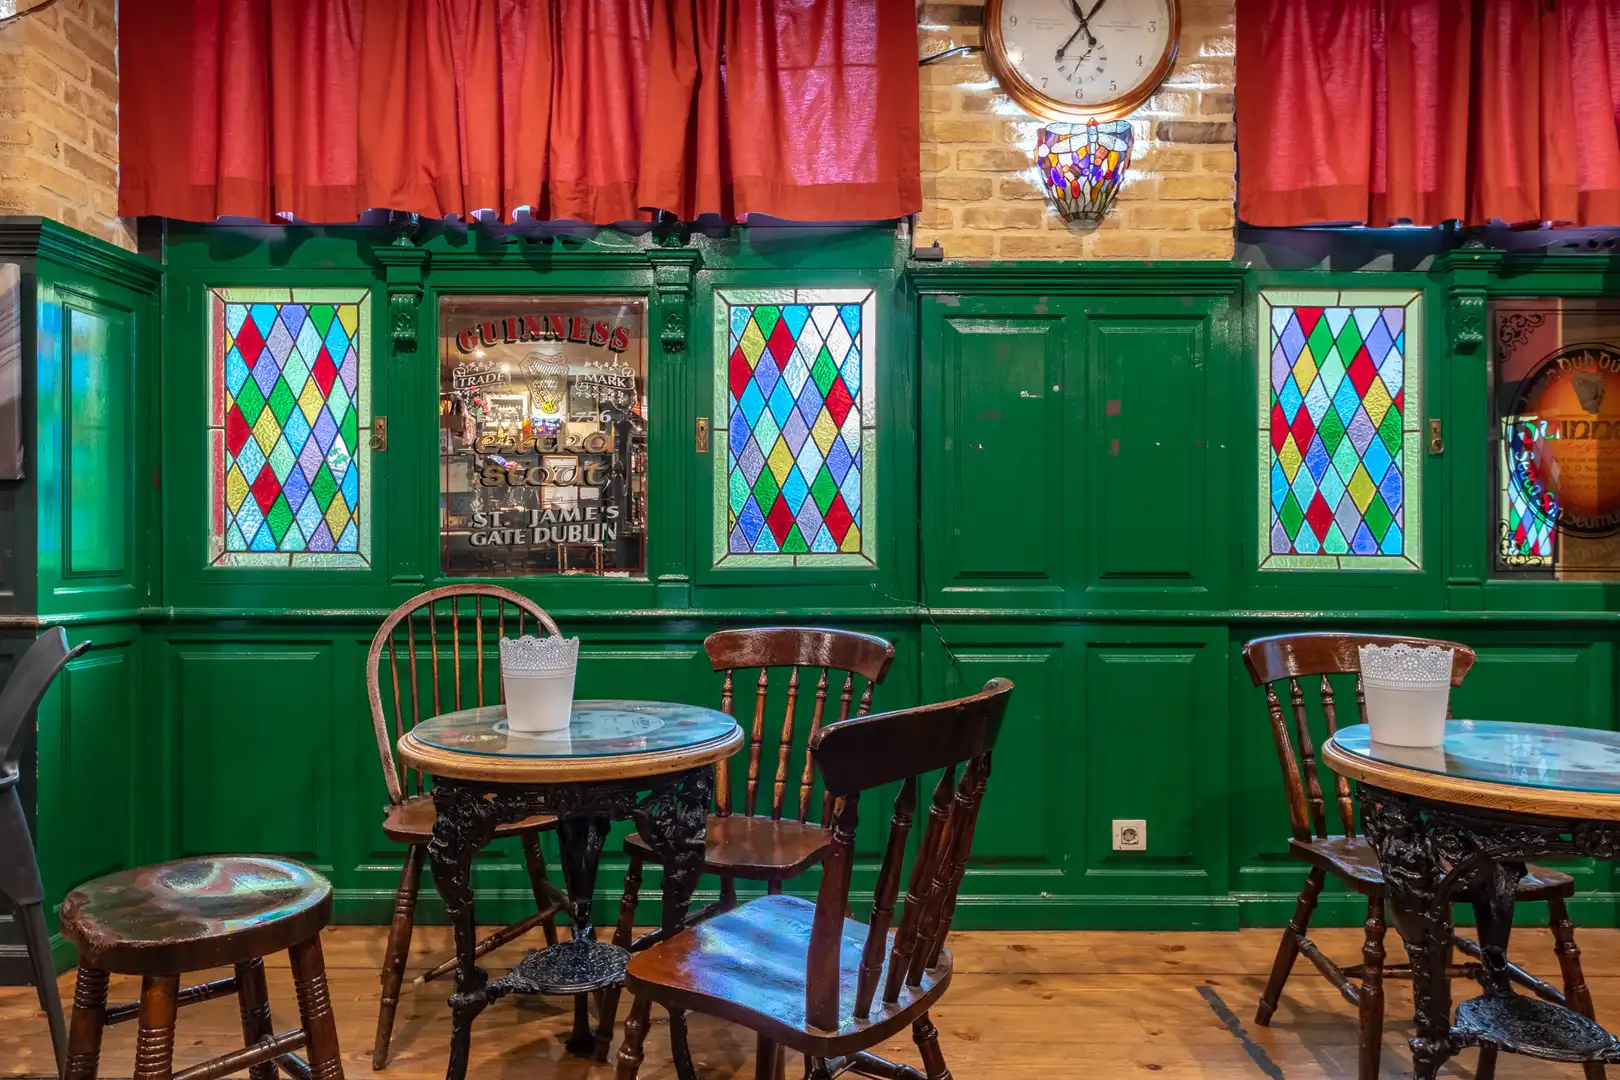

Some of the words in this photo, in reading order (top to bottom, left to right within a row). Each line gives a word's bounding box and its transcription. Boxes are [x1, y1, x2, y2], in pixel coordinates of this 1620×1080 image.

[1009, 15, 1018, 28] 9
[1147, 21, 1157, 33] 3
[1135, 55, 1144, 67] 4
[1040, 77, 1049, 89] 7
[1109, 80, 1117, 92] 5
[1075, 89, 1084, 100] 6
[457, 315, 631, 353] GUINNESS
[458, 371, 505, 388] TRADE
[584, 371, 627, 388] MARK
[471, 510, 510, 530] ST.
[529, 505, 620, 527] JAME'S
[470, 529, 526, 547] GATE
[532, 523, 617, 545] DUBLIN
